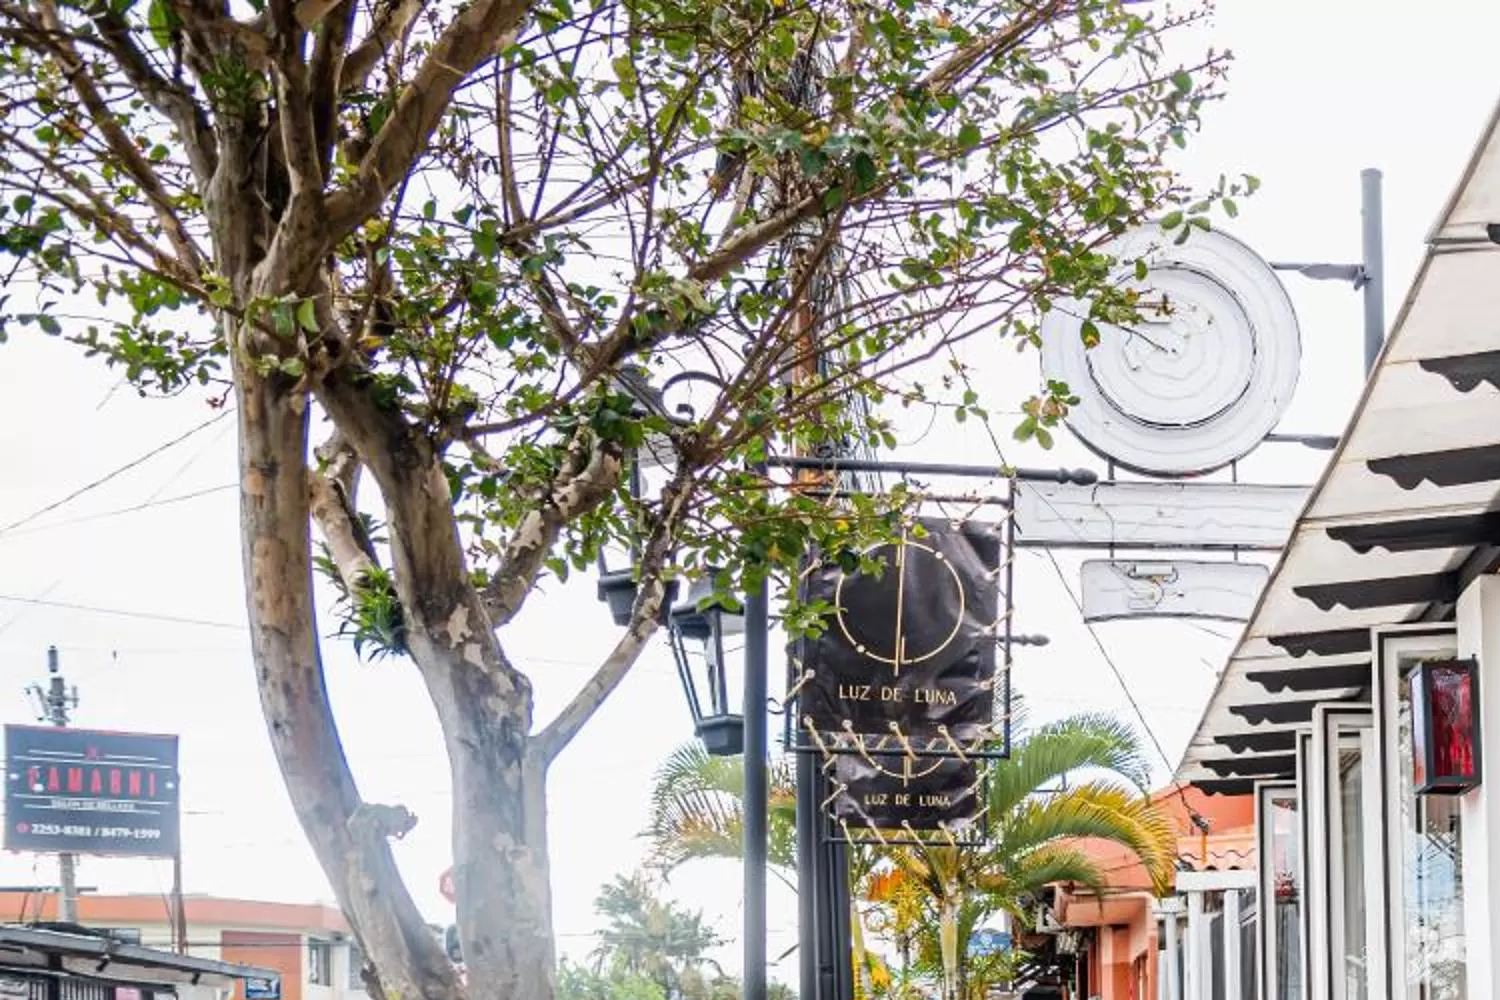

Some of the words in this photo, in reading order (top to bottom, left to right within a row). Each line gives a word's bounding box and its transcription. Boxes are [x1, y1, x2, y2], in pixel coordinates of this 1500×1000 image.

[839, 684, 871, 701] LUZ
[881, 686, 902, 703] DE
[914, 687, 957, 706] LUNA
[864, 793, 888, 805] LUZ
[895, 793, 912, 807] DE
[919, 795, 952, 808] LUNA
